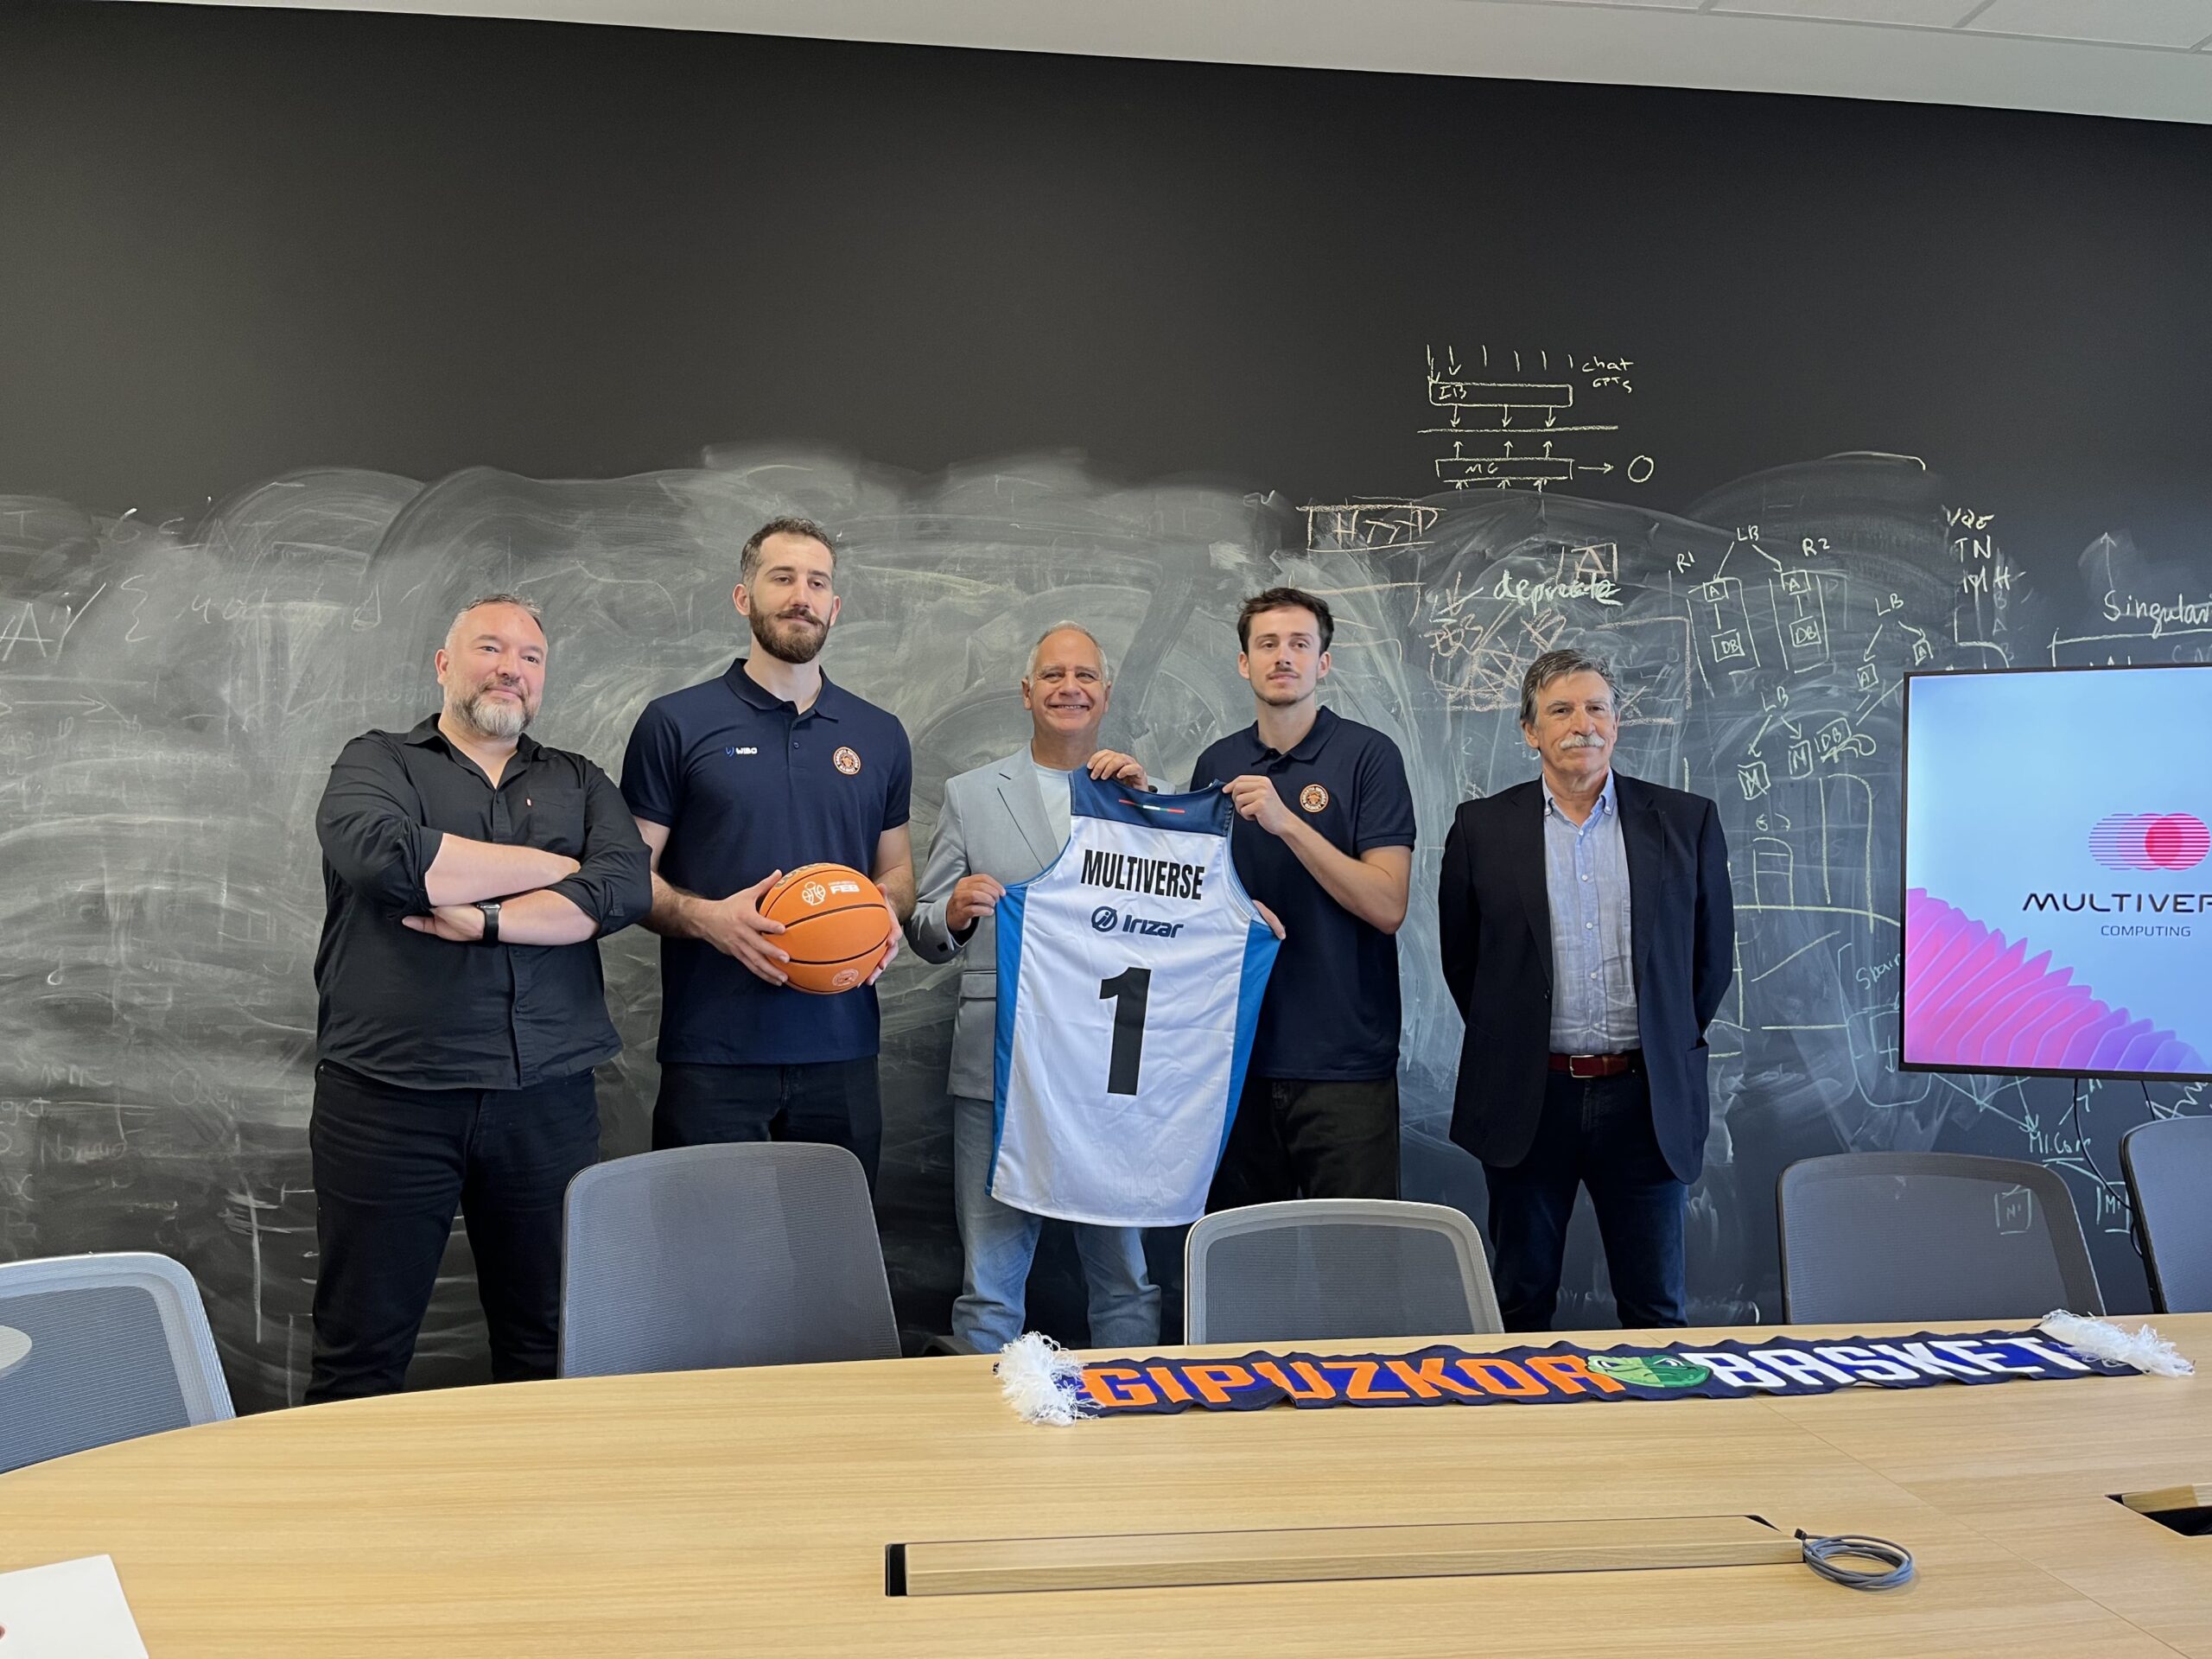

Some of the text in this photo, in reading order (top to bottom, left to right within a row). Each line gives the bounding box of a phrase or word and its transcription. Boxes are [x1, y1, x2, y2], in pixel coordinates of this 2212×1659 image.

[1582, 355, 1634, 372] chat
[1737, 524, 1759, 542] LB
[1802, 537, 1830, 557] R2
[1874, 593, 1904, 617] LB
[2102, 589, 2212, 639] Singular
[1795, 623, 1818, 644] DB
[1721, 639, 1739, 656] DB
[1760, 685, 1789, 713] LB
[1080, 849, 1205, 900] MULTIVERSE
[2101, 925, 2191, 938] COMPUTING
[1099, 966, 1152, 1096] 1
[1678, 1336, 2091, 1388] BASKET
